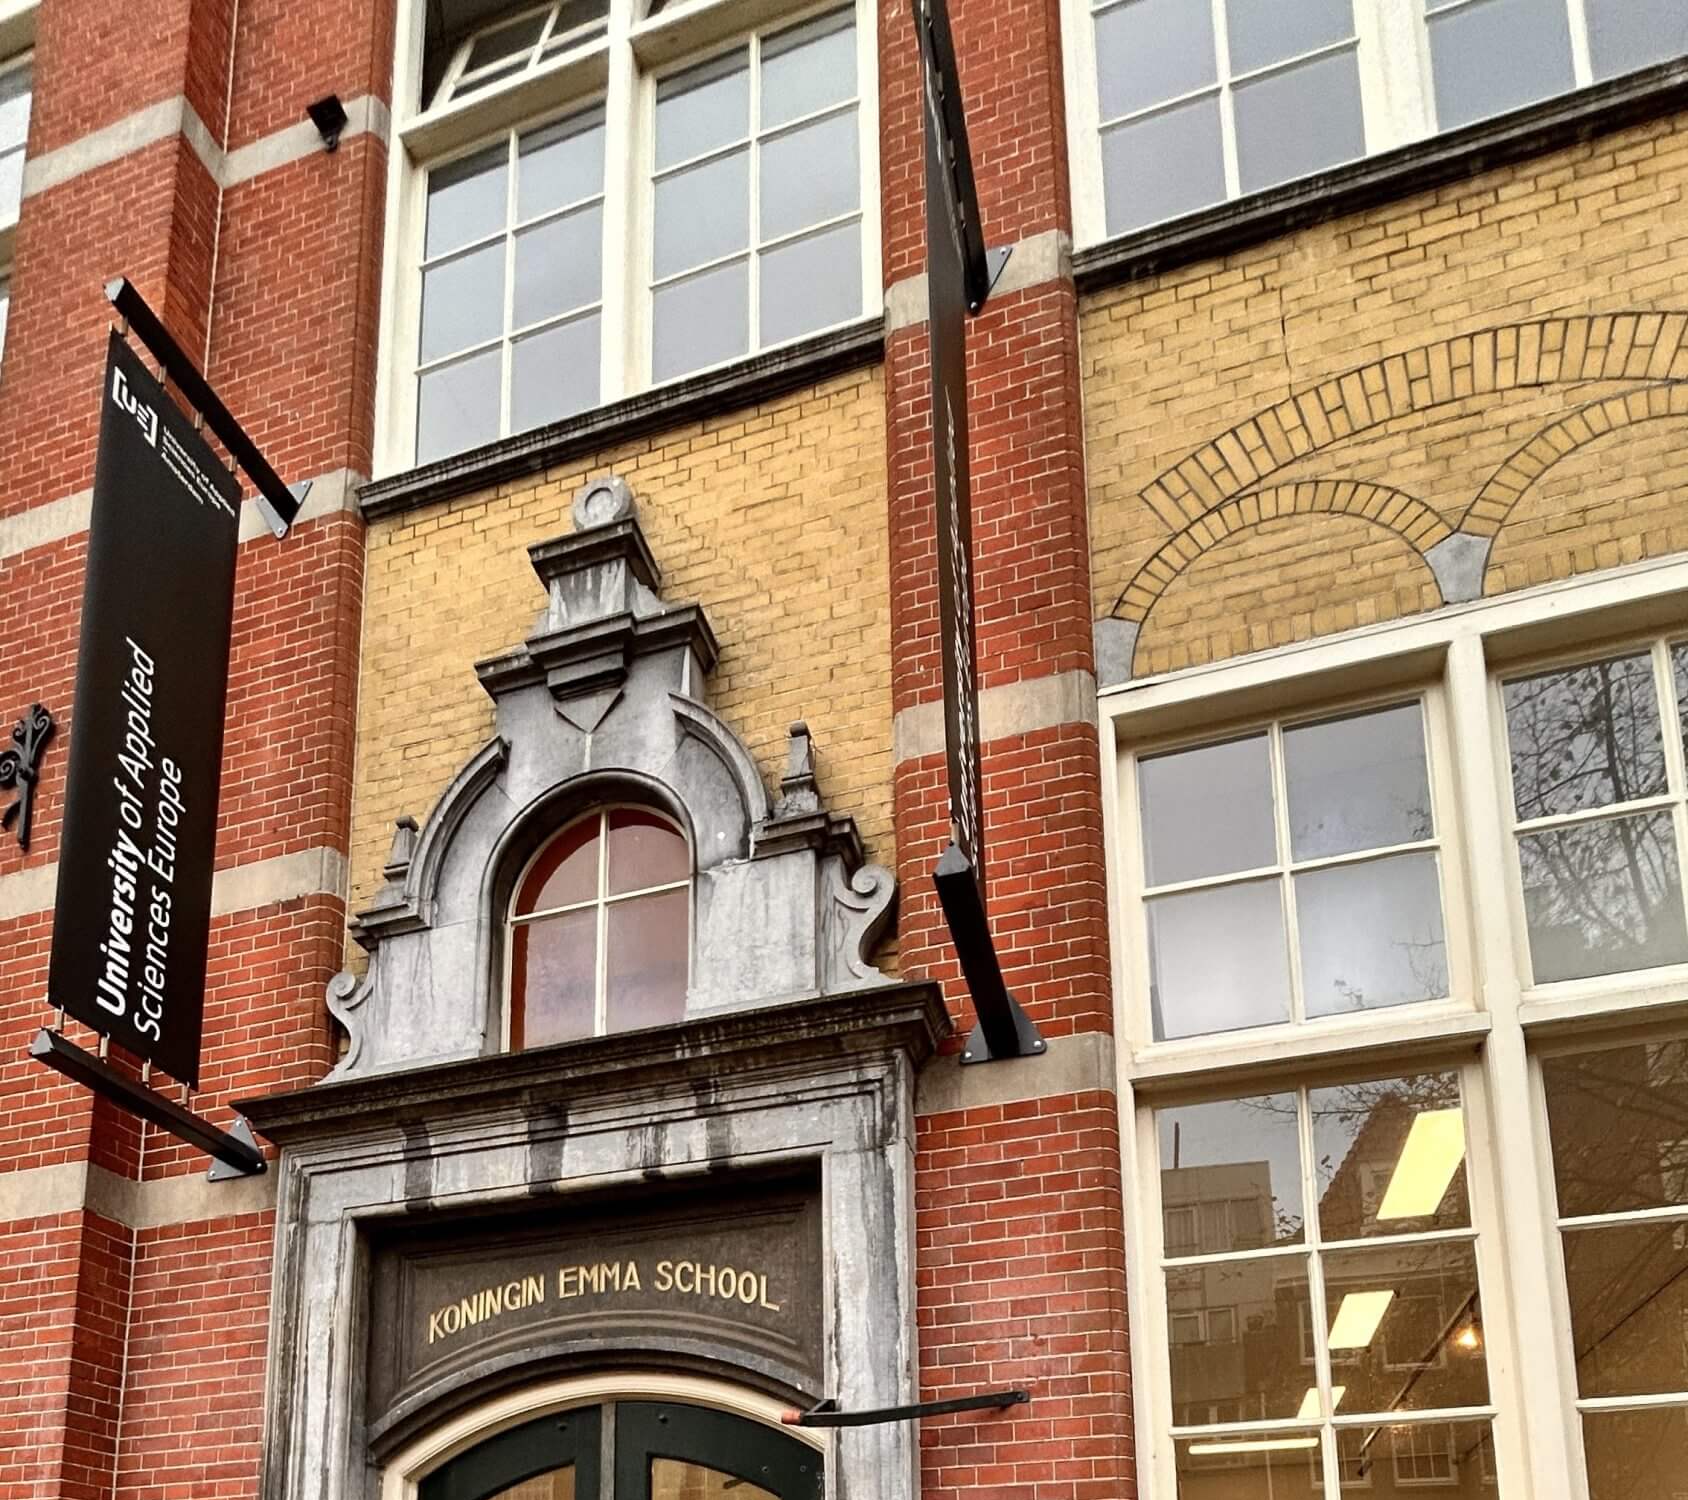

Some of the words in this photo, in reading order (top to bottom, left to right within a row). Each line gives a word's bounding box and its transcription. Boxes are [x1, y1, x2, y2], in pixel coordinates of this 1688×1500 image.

[118, 636, 156, 790] Applied
[113, 776, 143, 829] of
[147, 757, 186, 884] Europe
[96, 828, 146, 1017] University
[134, 885, 172, 1042] Sciences
[428, 1273, 546, 1344] KONINGIN
[558, 1260, 642, 1299] EMMA
[653, 1260, 781, 1312] SCHOOL
